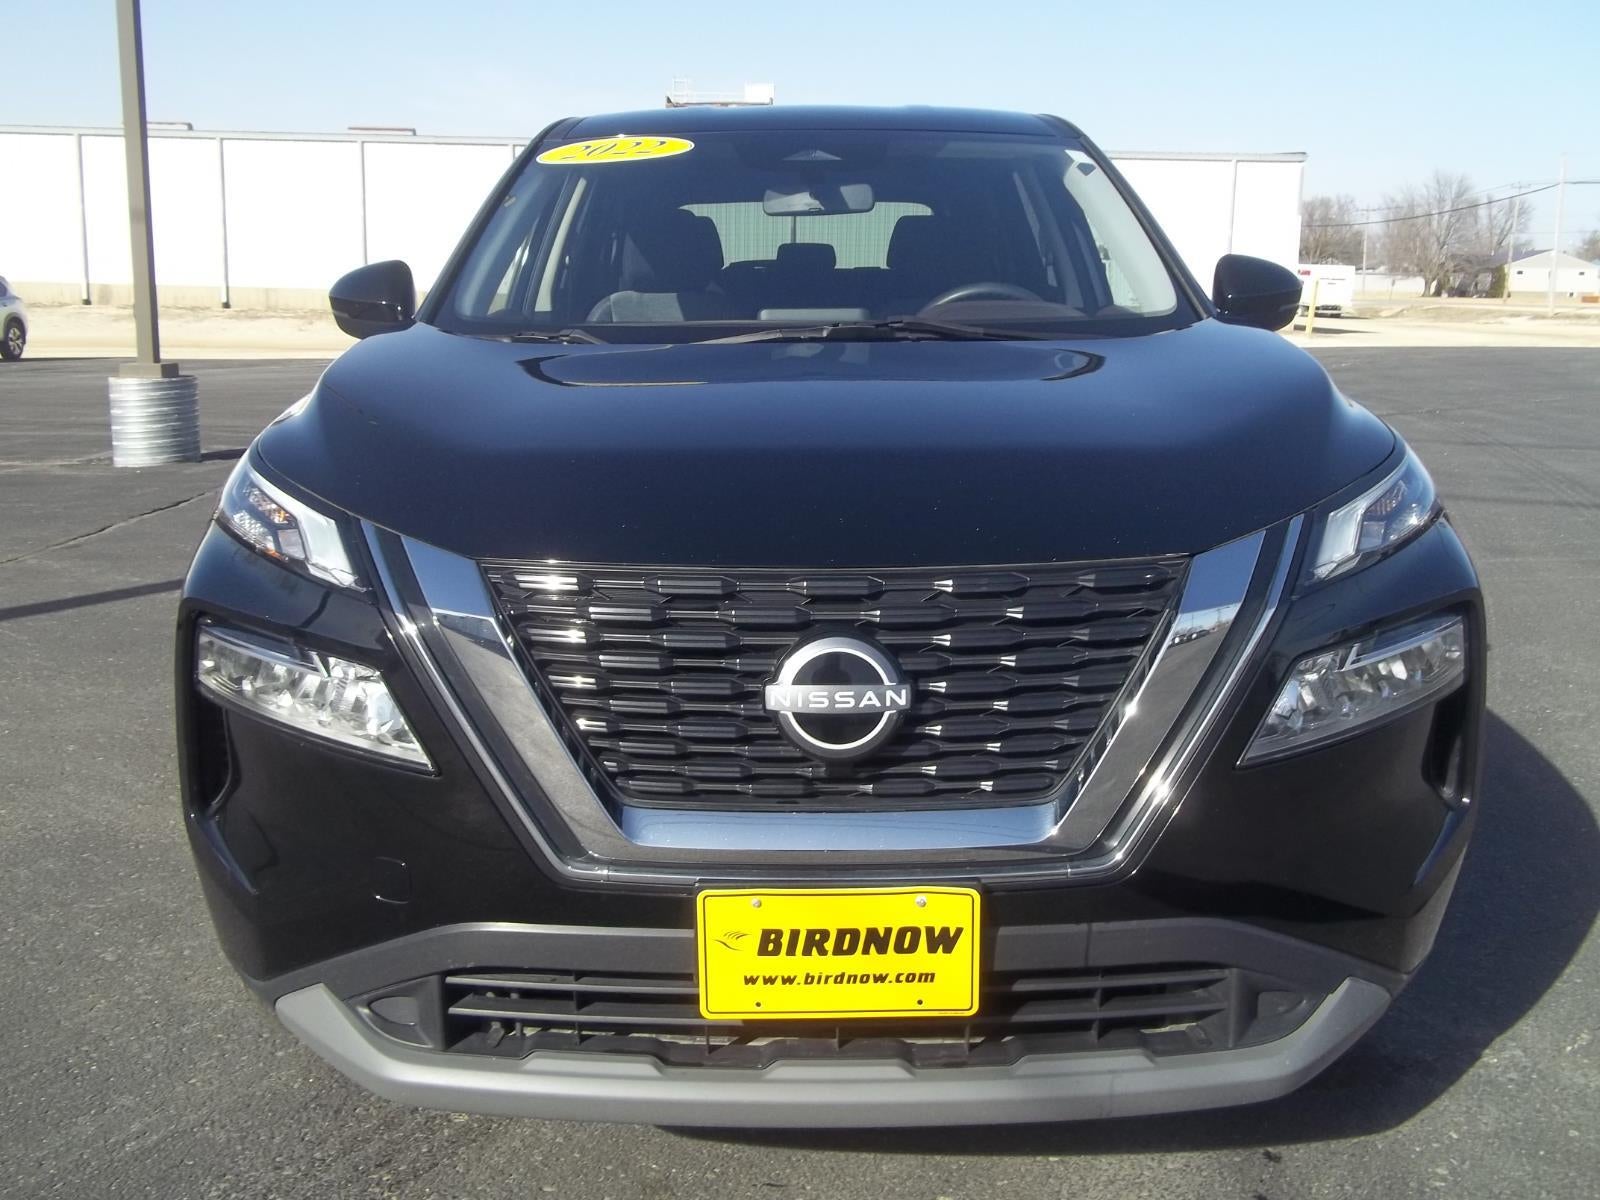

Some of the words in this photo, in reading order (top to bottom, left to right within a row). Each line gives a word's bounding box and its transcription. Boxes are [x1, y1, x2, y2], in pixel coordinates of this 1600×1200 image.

[561, 140, 667, 159] 2022
[770, 688, 907, 708] NISSAN
[757, 926, 964, 957] BIRDNOW
[743, 971, 936, 986] www.birdnow.com
